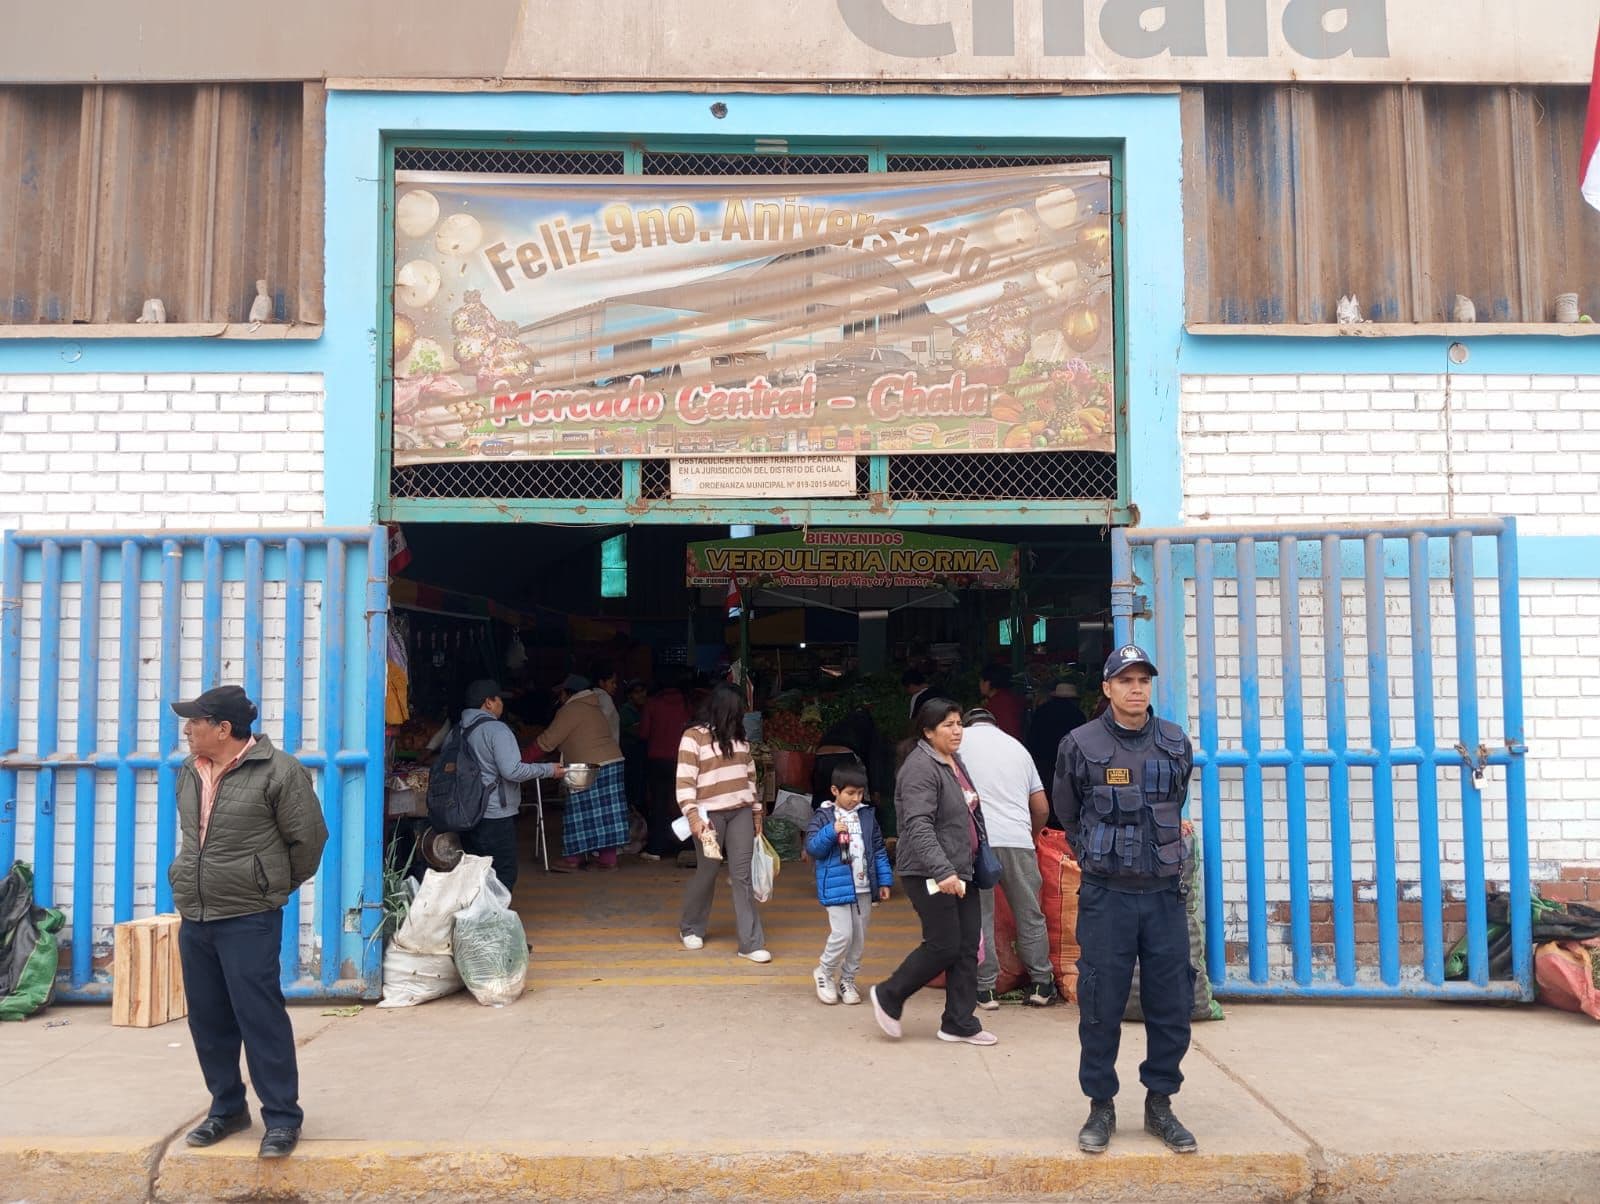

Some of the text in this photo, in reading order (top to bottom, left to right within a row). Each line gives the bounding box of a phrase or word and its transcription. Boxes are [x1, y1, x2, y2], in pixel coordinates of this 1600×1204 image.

[484, 195, 993, 292] Feliz 9no. Aniversario
[490, 374, 665, 426] Mercado
[675, 372, 818, 424] Central
[866, 371, 990, 420] Chala
[736, 455, 746, 464] EL
[746, 455, 769, 464] LIBRE
[678, 466, 689, 475] EN
[690, 466, 700, 474] LA
[701, 465, 752, 474] JURISDICCIÓN
[754, 466, 768, 474] DEL
[769, 465, 803, 474] DISTRITO
[804, 465, 814, 473] DE
[699, 481, 745, 489] ORDENANZA
[746, 480, 786, 489] MUNICIPAL
[807, 532, 903, 545] BIENVENIDOS
[705, 549, 999, 572] VERDULERIA NORMA
[781, 576, 818, 587] Ventas
[820, 576, 831, 586] al
[832, 577, 851, 588] por
[851, 576, 884, 588] Mayor
[895, 575, 929, 586] Menor
